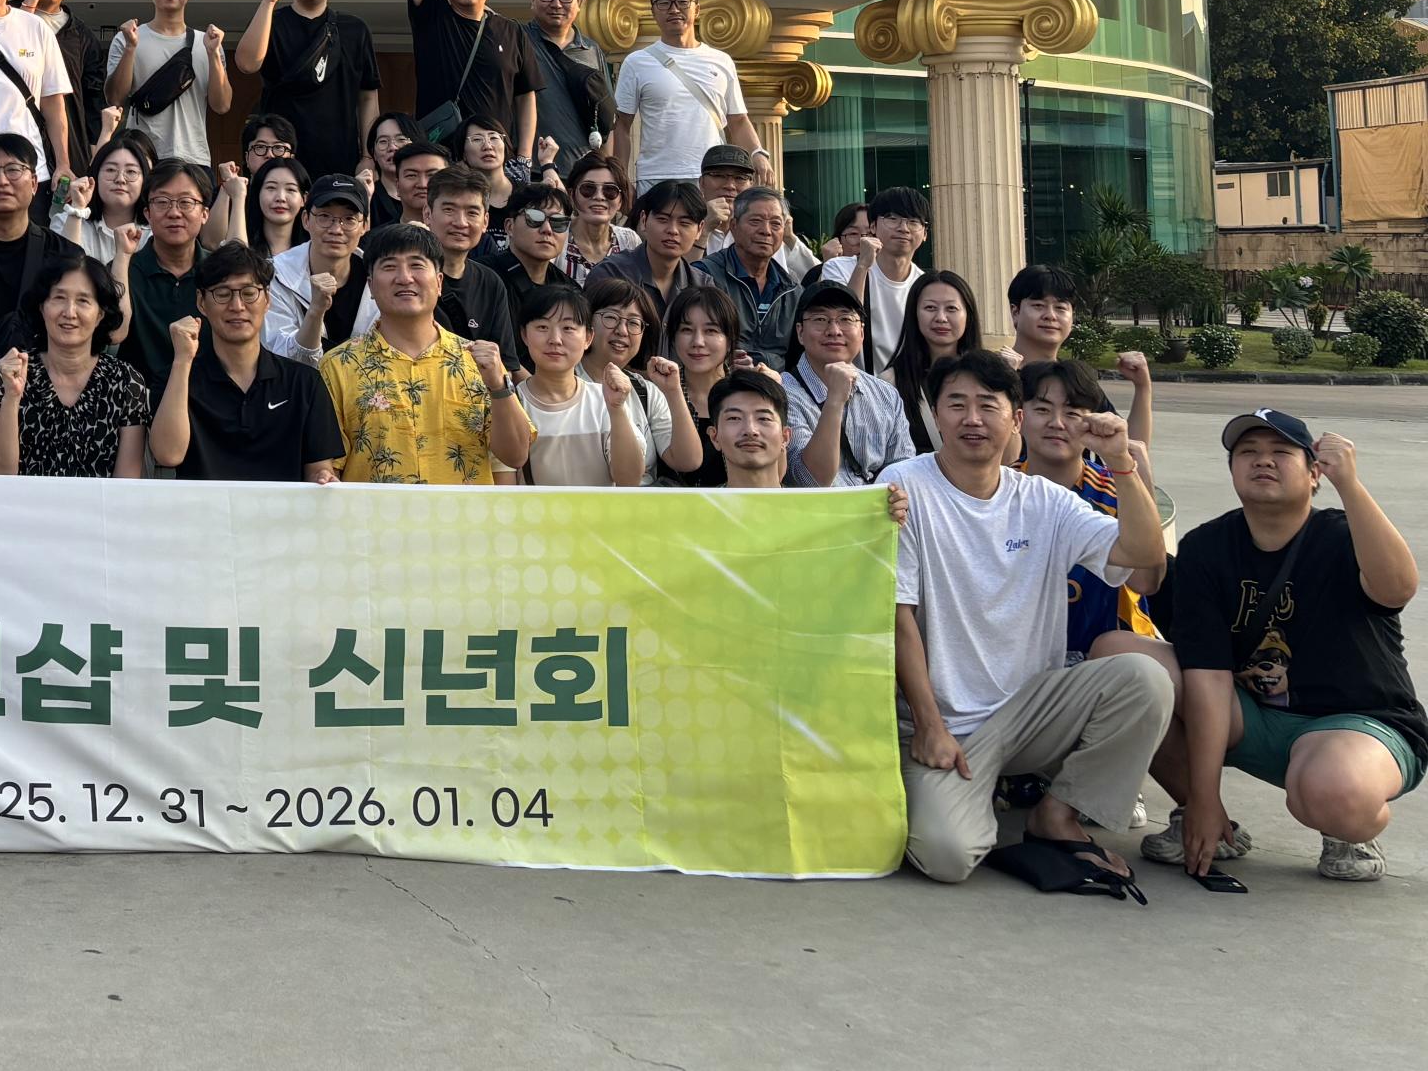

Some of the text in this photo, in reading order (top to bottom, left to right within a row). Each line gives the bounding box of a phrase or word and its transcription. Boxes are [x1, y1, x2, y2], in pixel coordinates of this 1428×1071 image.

[165, 626, 263, 729] 및
[308, 626, 629, 728] 신년회
[82, 783, 144, 823] 12.
[159, 787, 205, 828] 31
[265, 786, 395, 828] 2026.
[412, 786, 474, 827] 01.
[491, 787, 554, 828] 04
